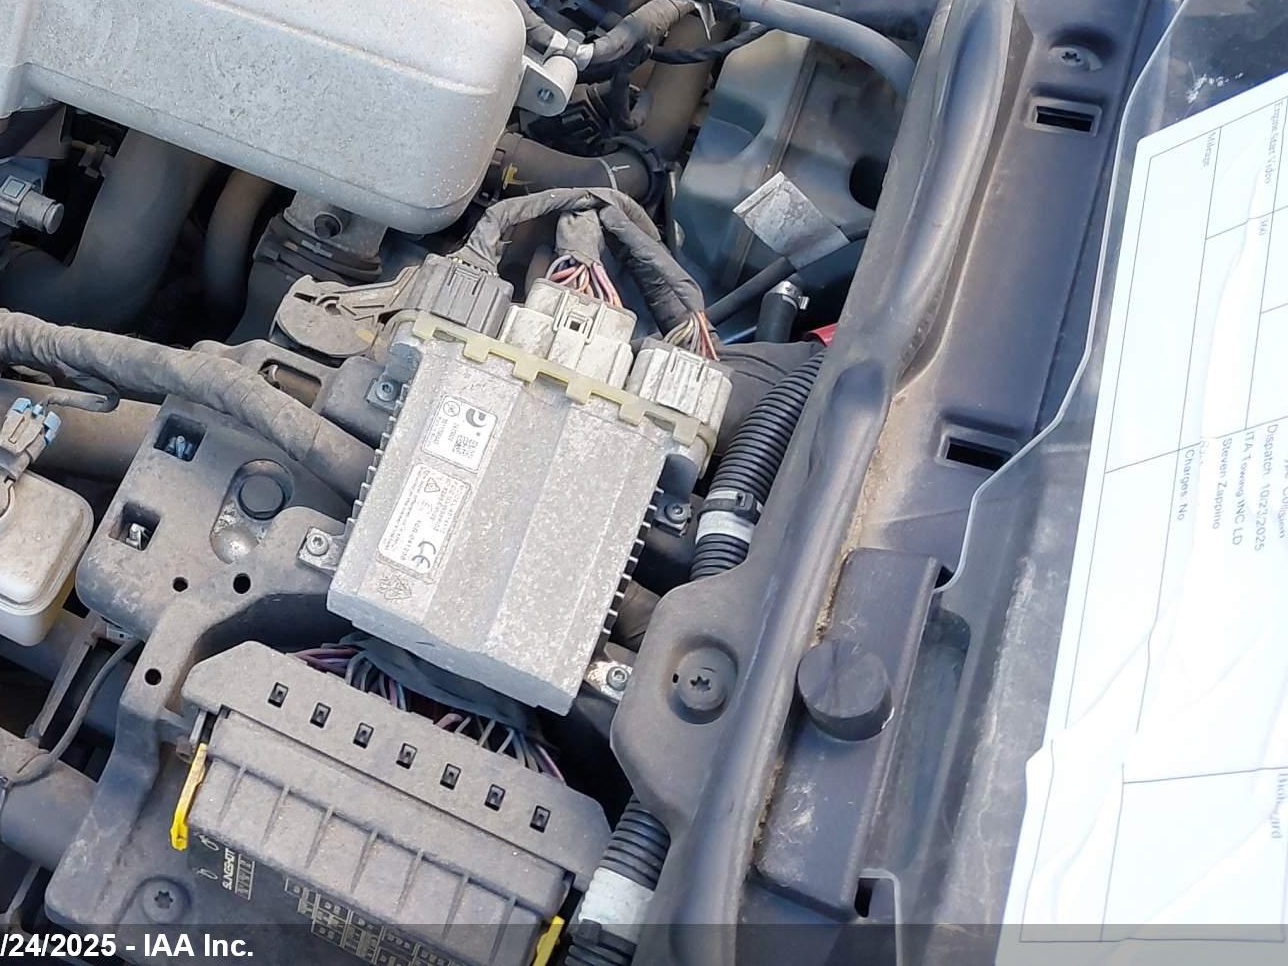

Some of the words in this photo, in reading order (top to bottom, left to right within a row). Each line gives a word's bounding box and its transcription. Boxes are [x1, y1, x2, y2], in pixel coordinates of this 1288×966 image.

[1264, 155, 1276, 184] Video
[1219, 438, 1233, 478] Steven
[1235, 454, 1251, 497] Towing
[1177, 503, 1188, 521] No
[1212, 481, 1228, 529] Zappino
[1234, 499, 1246, 524] INC
